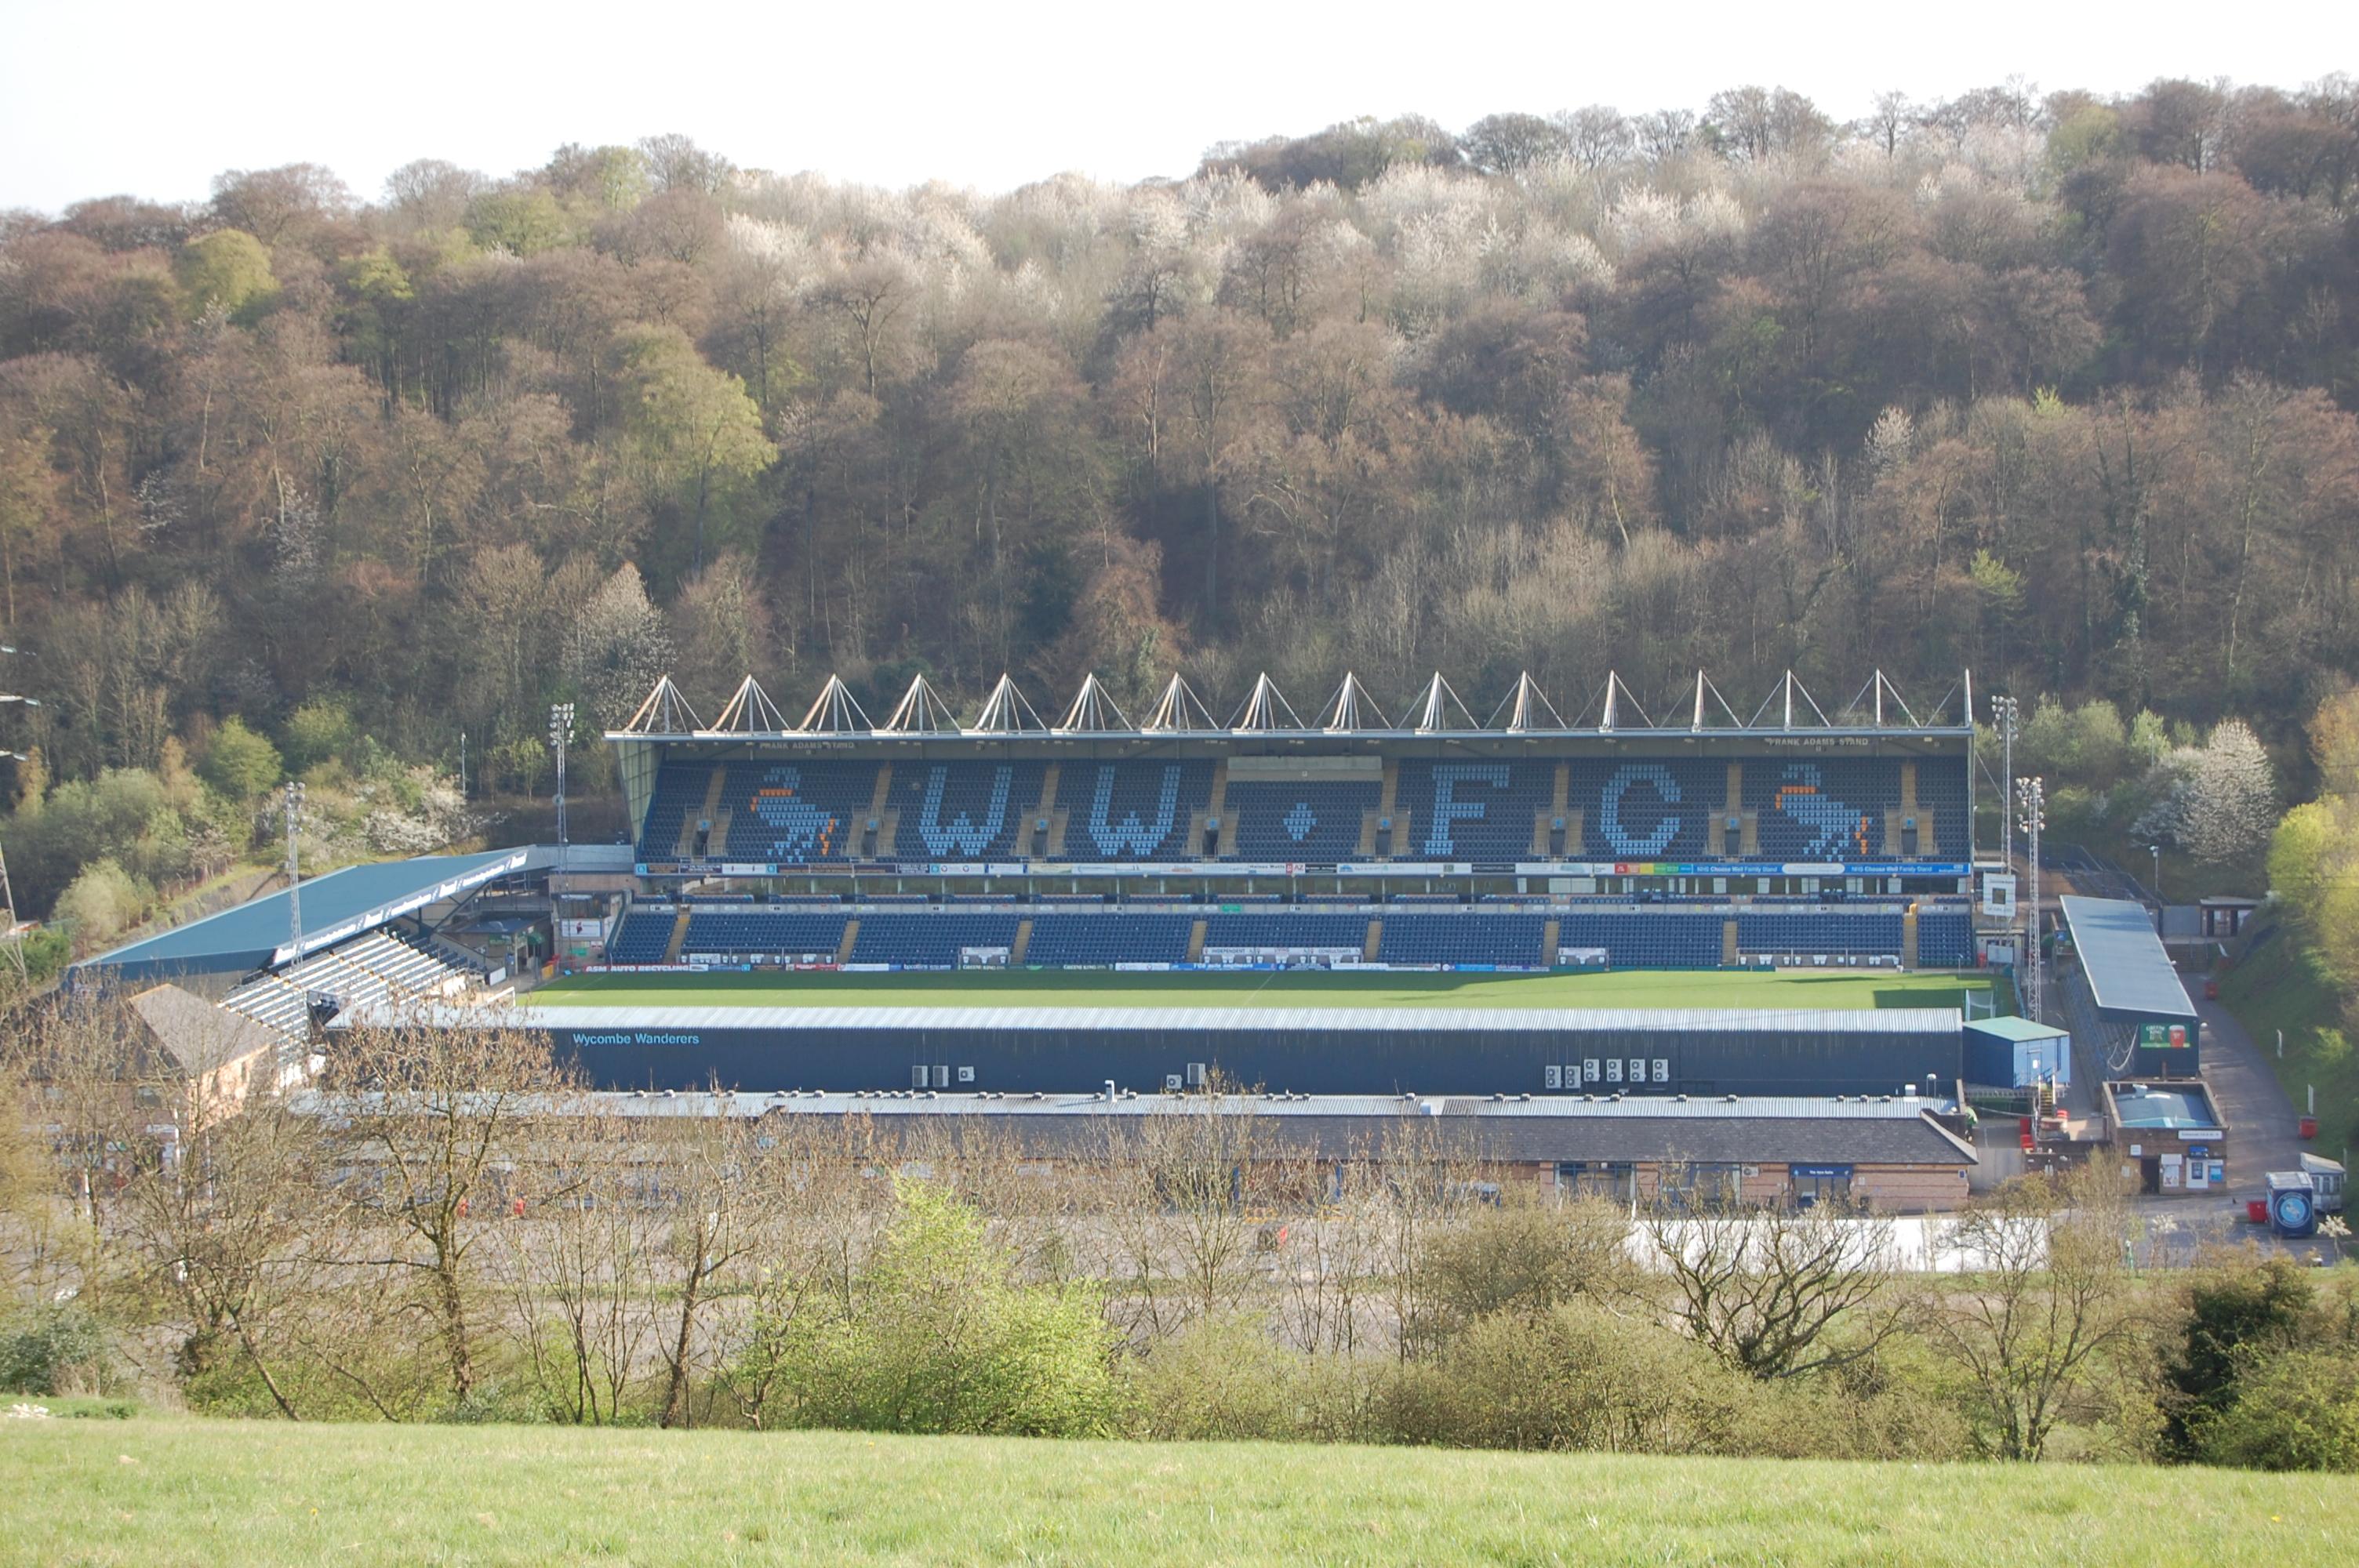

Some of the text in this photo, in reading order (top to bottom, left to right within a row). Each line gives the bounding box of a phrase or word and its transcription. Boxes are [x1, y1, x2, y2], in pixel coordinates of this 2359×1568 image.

[1804, 737, 1834, 746] ADAMS
[1839, 737, 1869, 746] STAND
[918, 763, 1681, 857] W W F C
[572, 1033, 700, 1047] Wycombe Wanderers
